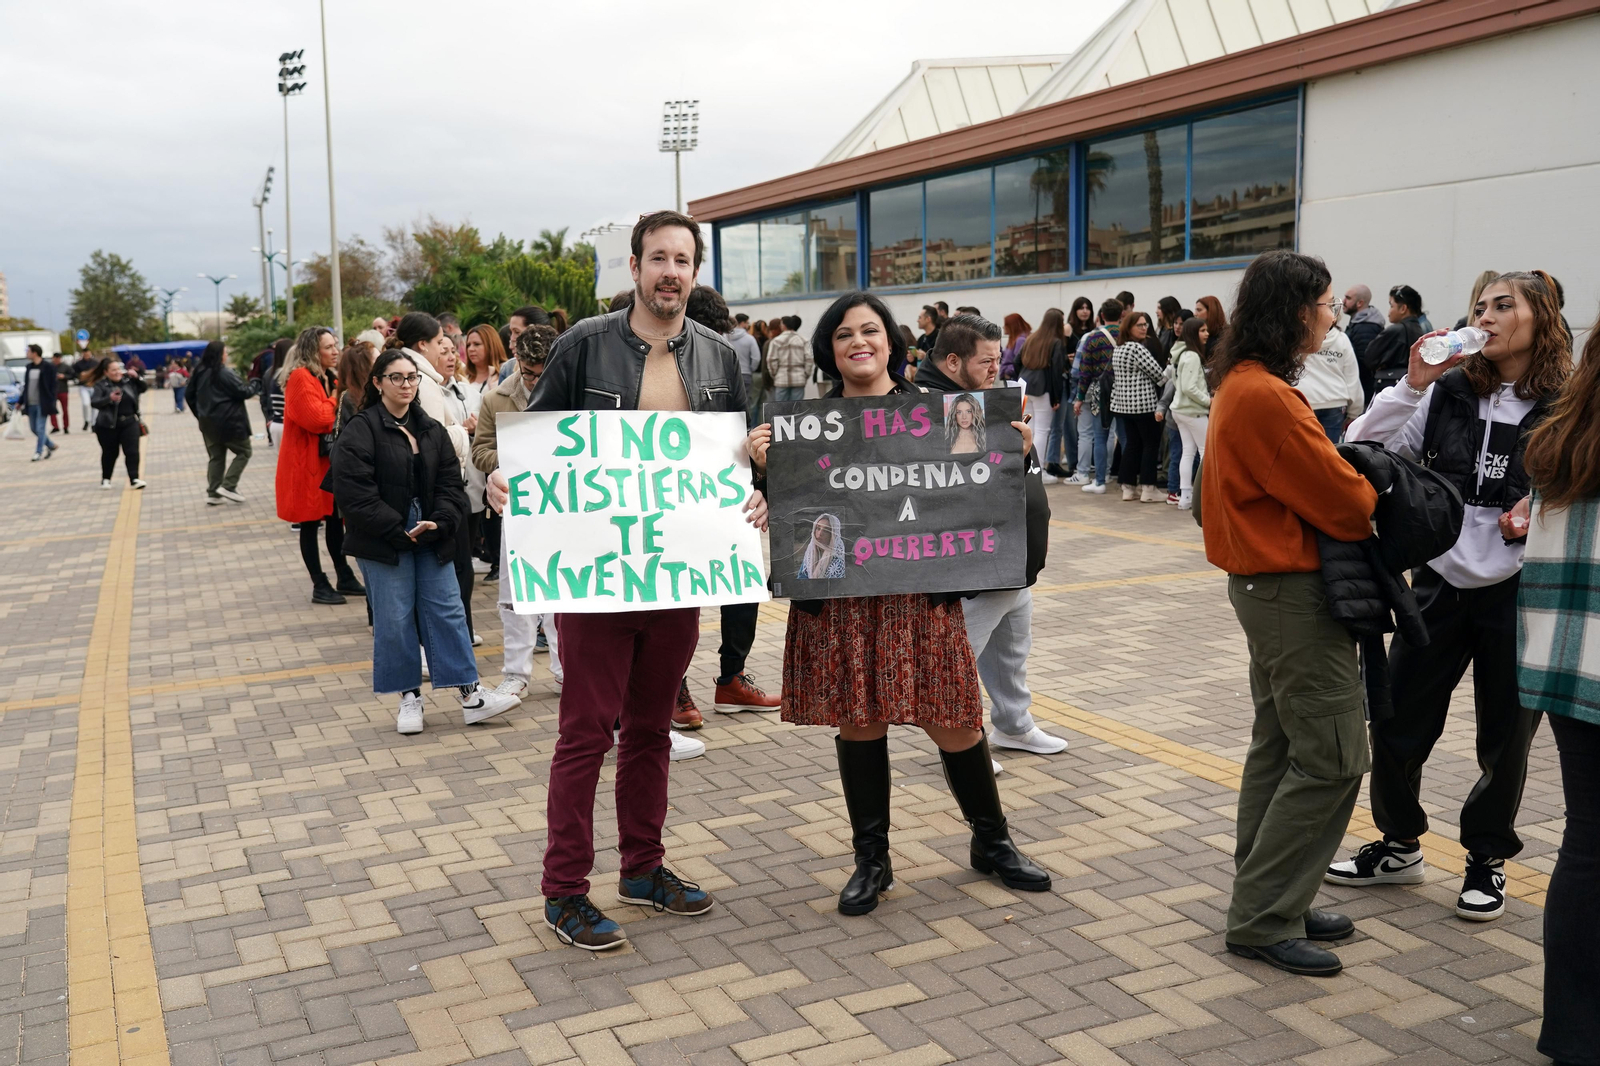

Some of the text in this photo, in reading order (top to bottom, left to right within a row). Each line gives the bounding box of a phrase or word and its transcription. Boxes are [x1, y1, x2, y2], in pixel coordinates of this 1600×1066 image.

[552, 410, 691, 461] SI NO
[773, 406, 932, 442] NOS HAS
[508, 461, 746, 517] EXISTIERAS
[817, 452, 1003, 492] "CONDENAO"
[898, 496, 917, 522] A
[610, 511, 665, 556] TE
[853, 529, 996, 566] QUERERTE
[509, 543, 764, 603] INVENTARÍA
